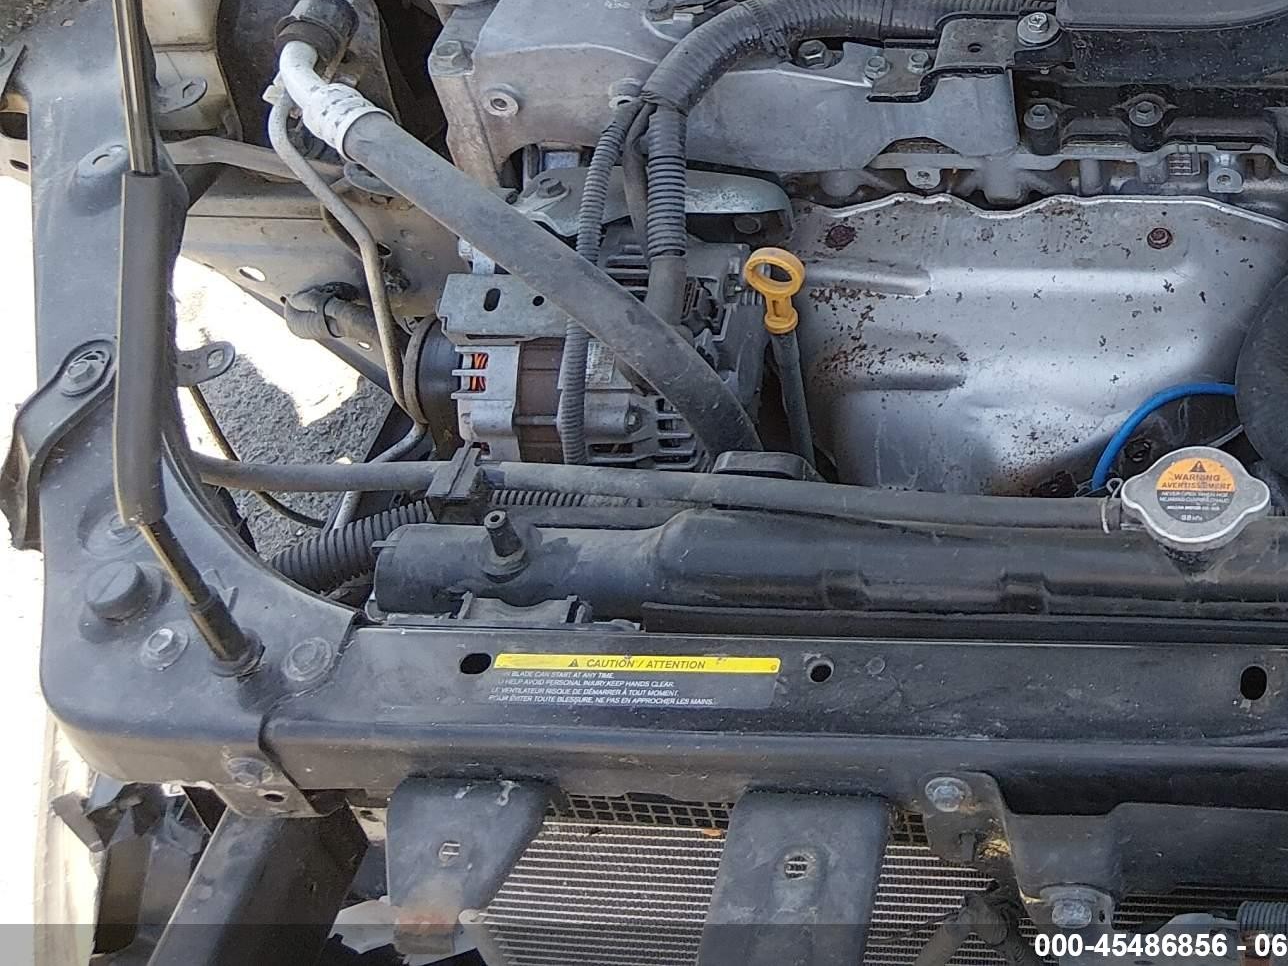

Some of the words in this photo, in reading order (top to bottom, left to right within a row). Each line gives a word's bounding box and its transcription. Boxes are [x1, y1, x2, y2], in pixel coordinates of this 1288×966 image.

[586, 659, 636, 668] CAUTION
[638, 660, 644, 668] /
[646, 660, 706, 669] ATTENTION
